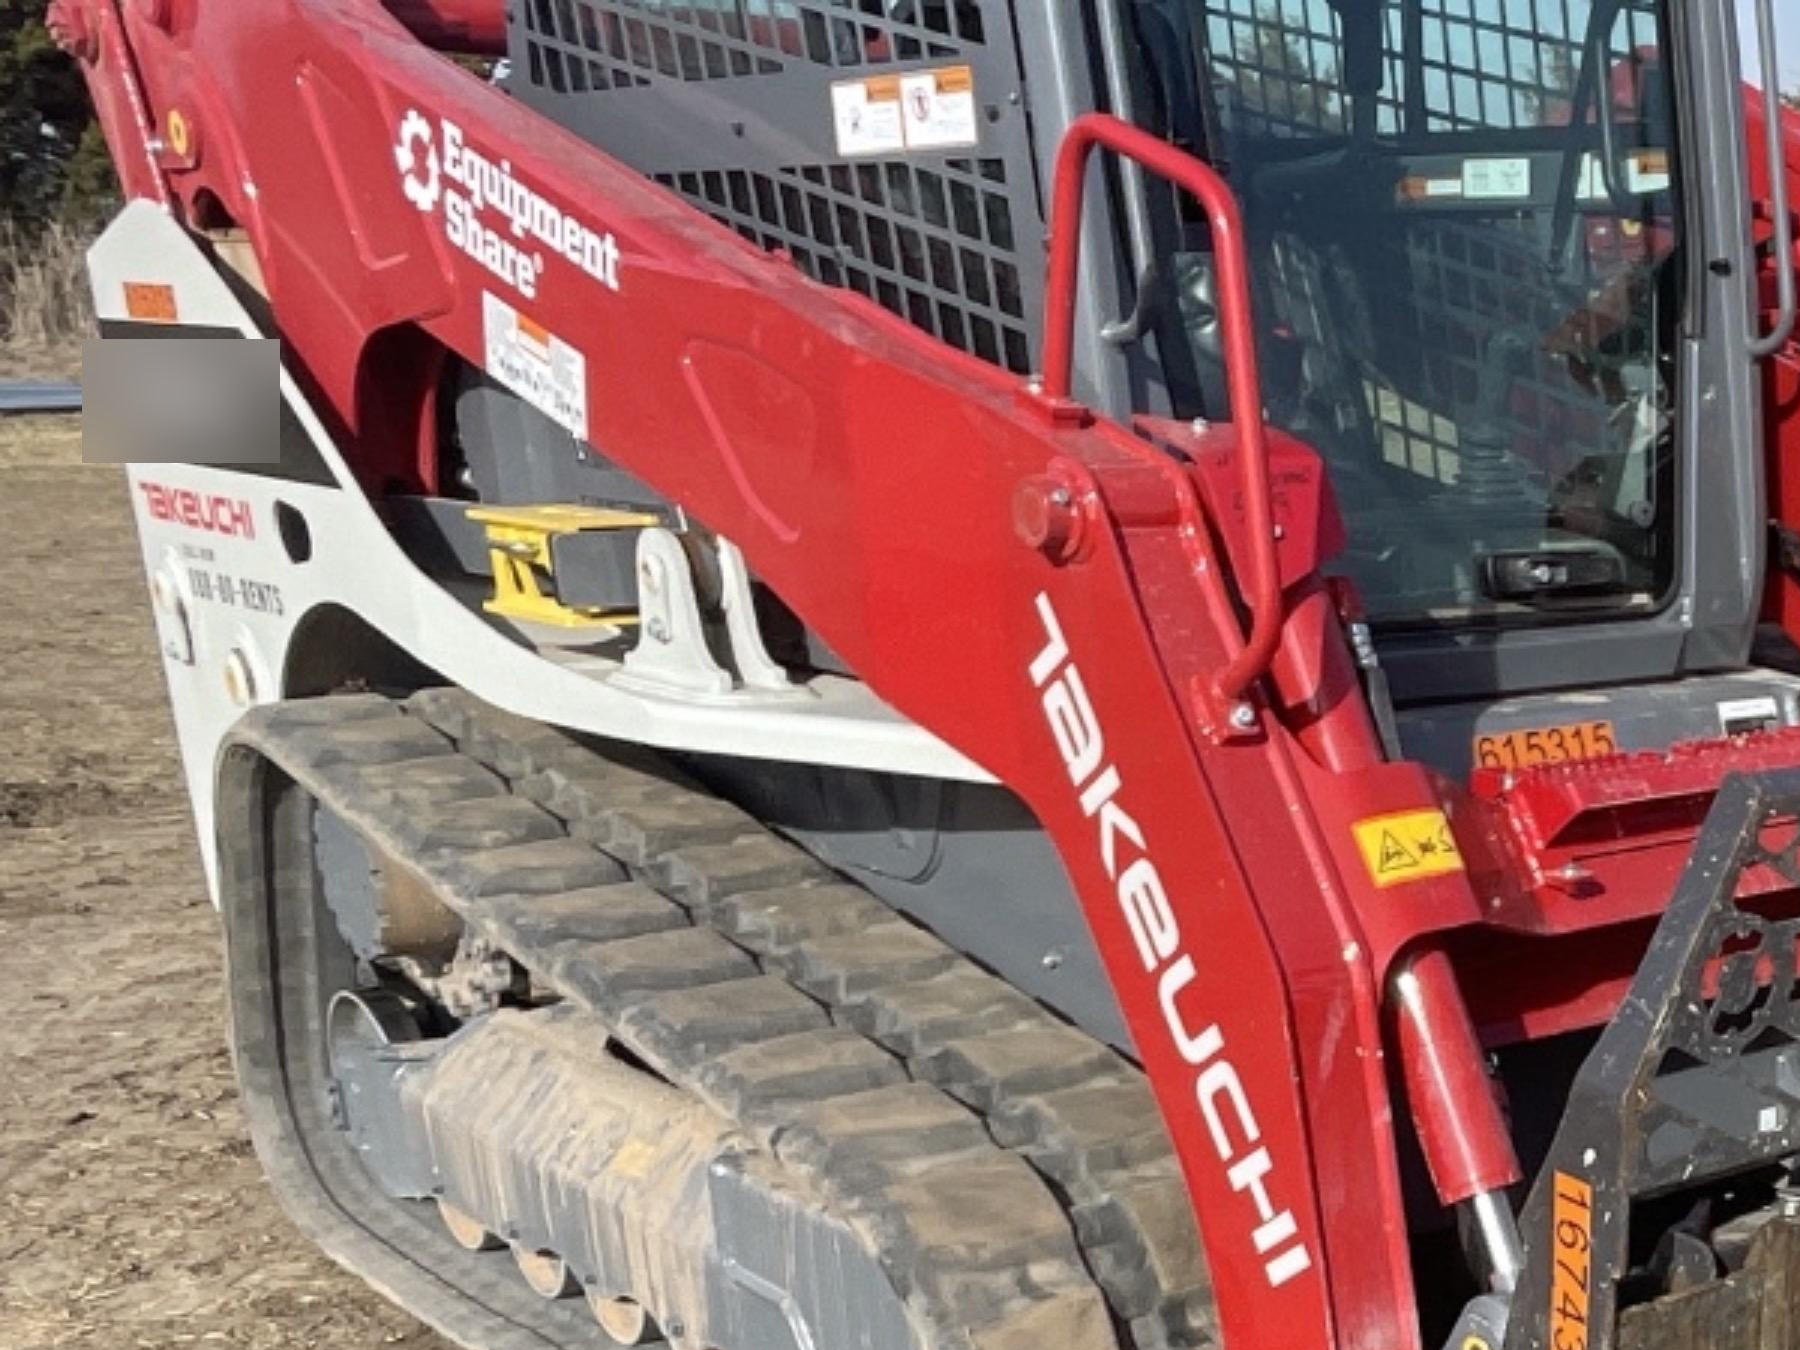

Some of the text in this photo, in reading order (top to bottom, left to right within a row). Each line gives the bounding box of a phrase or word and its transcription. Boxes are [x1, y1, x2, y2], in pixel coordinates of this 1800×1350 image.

[440, 116, 620, 291] Equipment
[138, 479, 256, 541] TAKEUCHI
[1477, 722, 1614, 769] 615315
[1029, 591, 1311, 1288] TAKEUCHI
